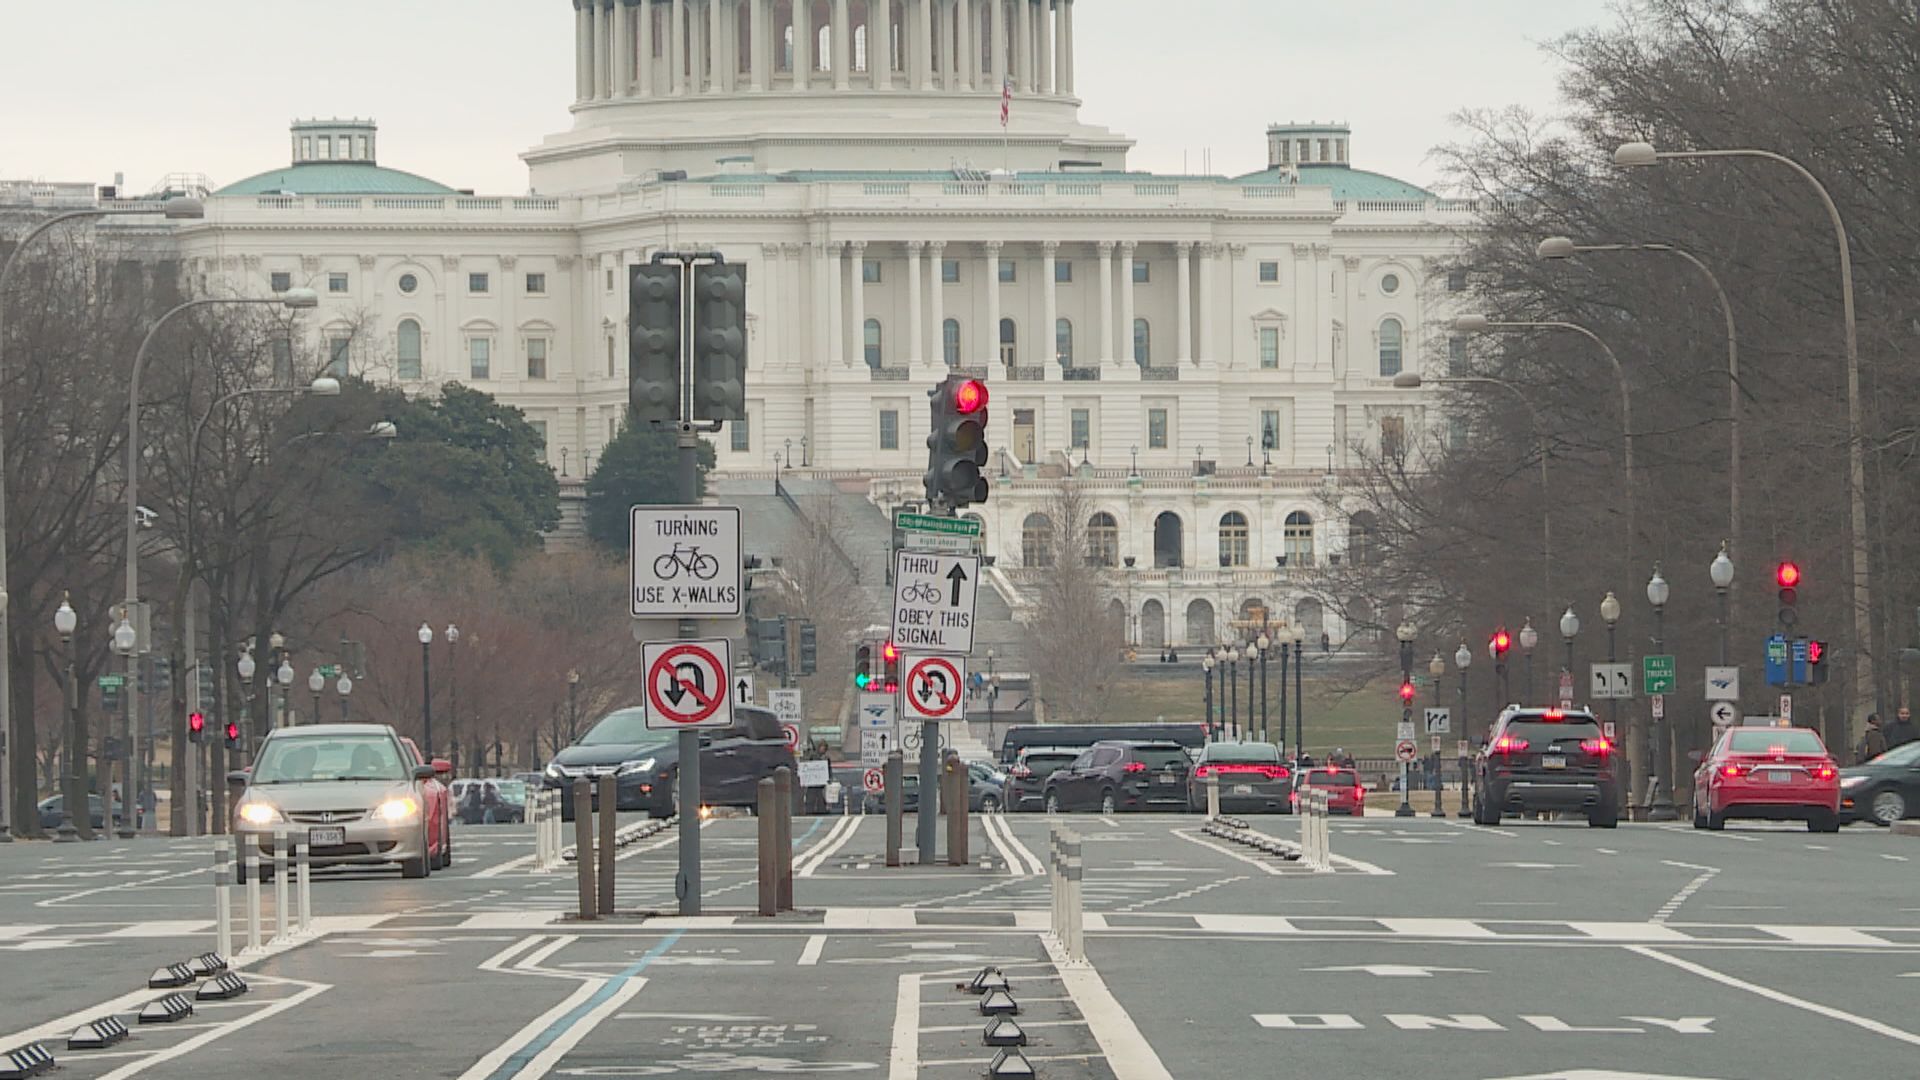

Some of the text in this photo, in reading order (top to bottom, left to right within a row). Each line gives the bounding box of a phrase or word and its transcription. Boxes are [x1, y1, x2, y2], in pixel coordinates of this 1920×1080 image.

[655, 519, 718, 536] TURNING
[902, 556, 939, 575] THRU
[636, 586, 736, 603] USE X-WALKS
[898, 608, 970, 629] OBEY THIS
[897, 628, 946, 646] SIGNAL
[1646, 669, 1673, 678] TRUCKS
[1250, 1012, 1717, 1034] ONLY
